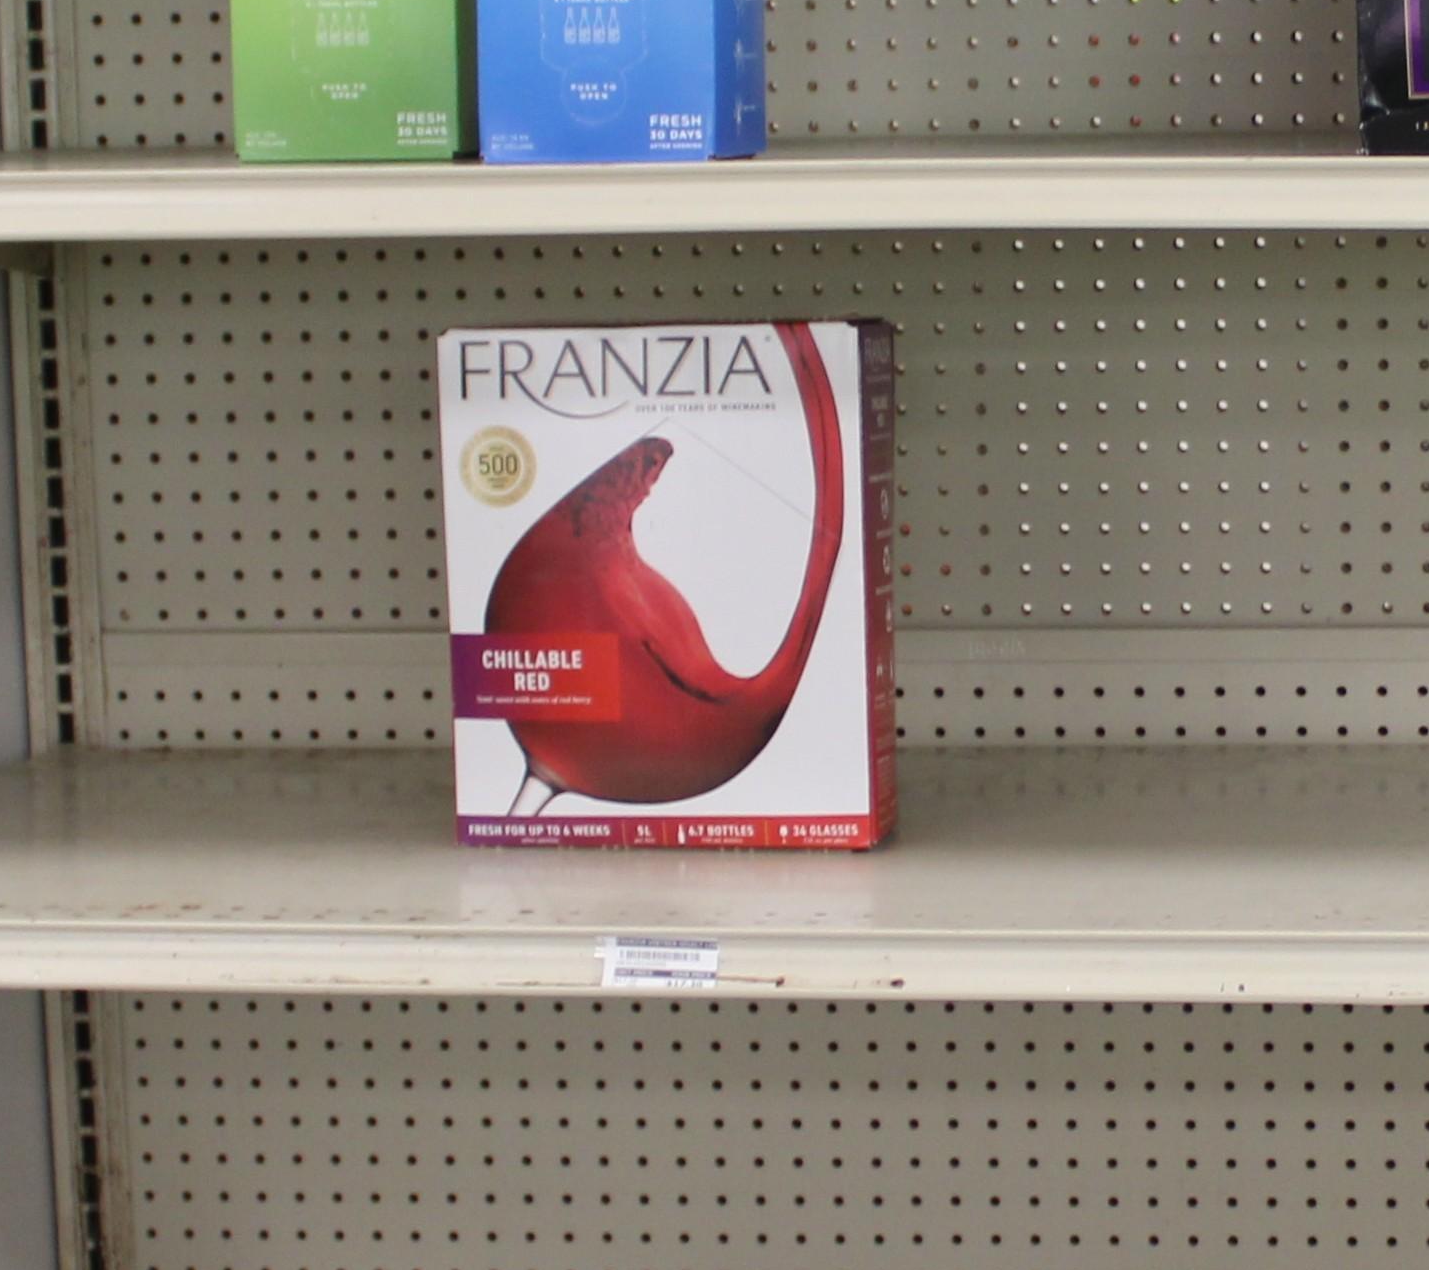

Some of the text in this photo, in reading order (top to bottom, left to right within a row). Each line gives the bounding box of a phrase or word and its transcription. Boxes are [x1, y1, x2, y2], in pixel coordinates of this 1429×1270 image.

[397, 112, 447, 124] FRESH
[649, 114, 702, 127] FRESH
[416, 125, 448, 136] DAYS
[670, 130, 702, 140] DAYS
[459, 334, 774, 420] FRANZIA
[478, 454, 518, 476] 500
[481, 649, 583, 670] CHILLABLE
[514, 671, 551, 692] RED
[468, 824, 611, 837] FRESH FOR UP TO 6 WEEKS
[688, 824, 755, 837] 6.7 BOTTLES
[809, 824, 859, 837] GLASSES
